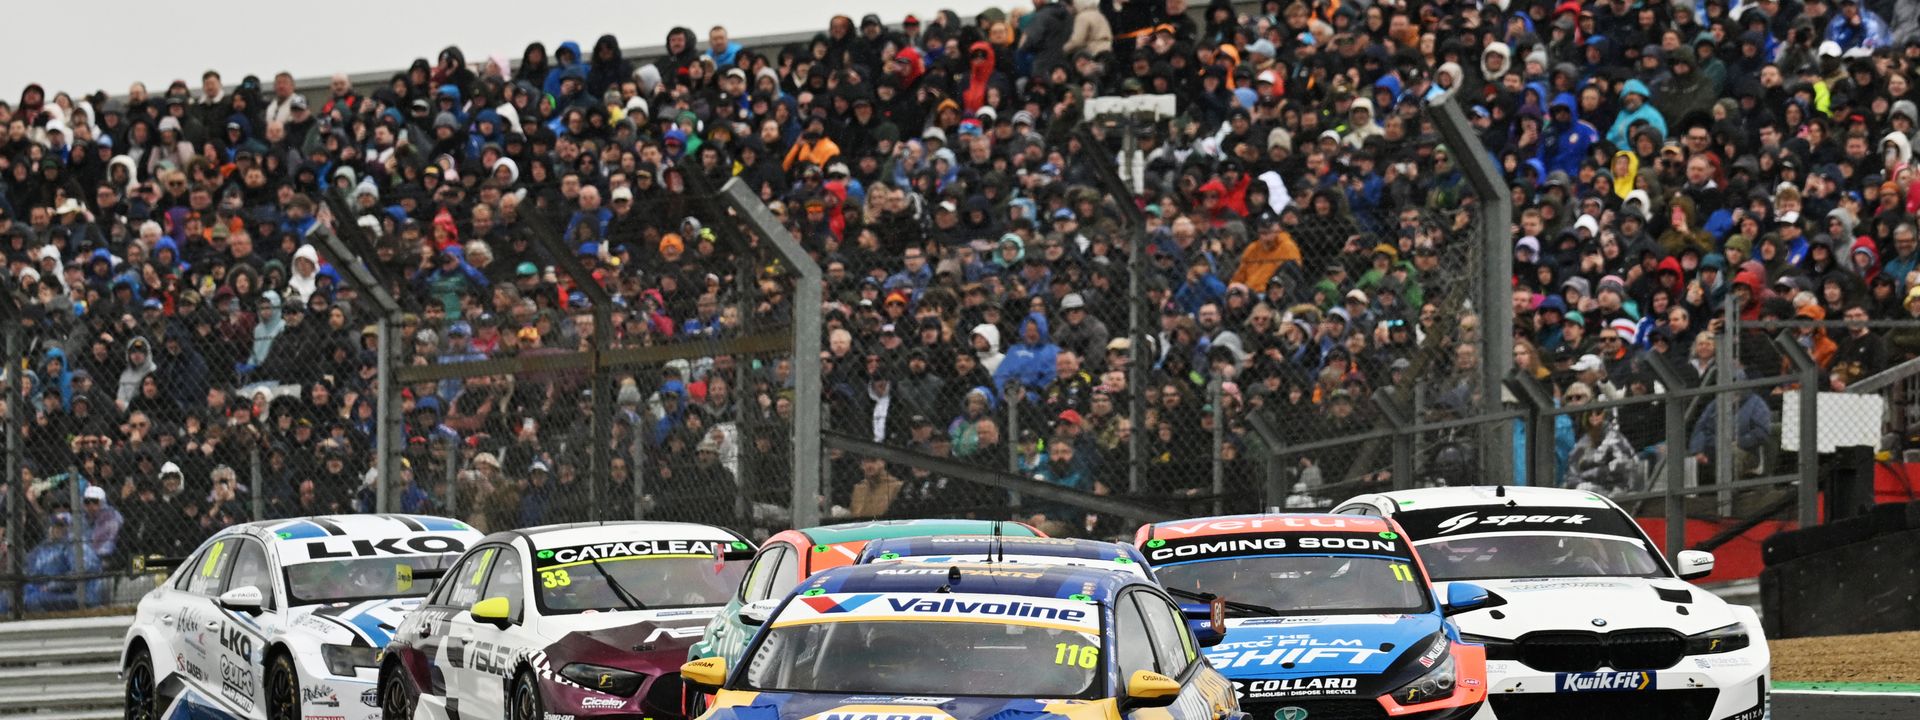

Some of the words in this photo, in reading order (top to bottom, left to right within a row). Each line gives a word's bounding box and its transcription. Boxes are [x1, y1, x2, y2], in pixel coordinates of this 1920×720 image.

[1166, 517, 1346, 534] vertu
[1478, 514, 1591, 526] spark
[306, 535, 466, 559] LKQ
[555, 541, 732, 563] CATACLEAN
[1152, 539, 1286, 560] COMING
[1299, 537, 1395, 552] SOON
[541, 569, 571, 588] 33
[1389, 564, 1413, 581] 11
[887, 597, 1086, 620] Valvoline
[220, 619, 252, 666] LKQ
[1212, 641, 1273, 652] BTCC
[1277, 638, 1364, 647] FILM
[1055, 642, 1099, 670] 116
[1205, 648, 1390, 670] SHIFT
[1249, 677, 1358, 691] COLLARD
[581, 697, 627, 709] Ciceley
